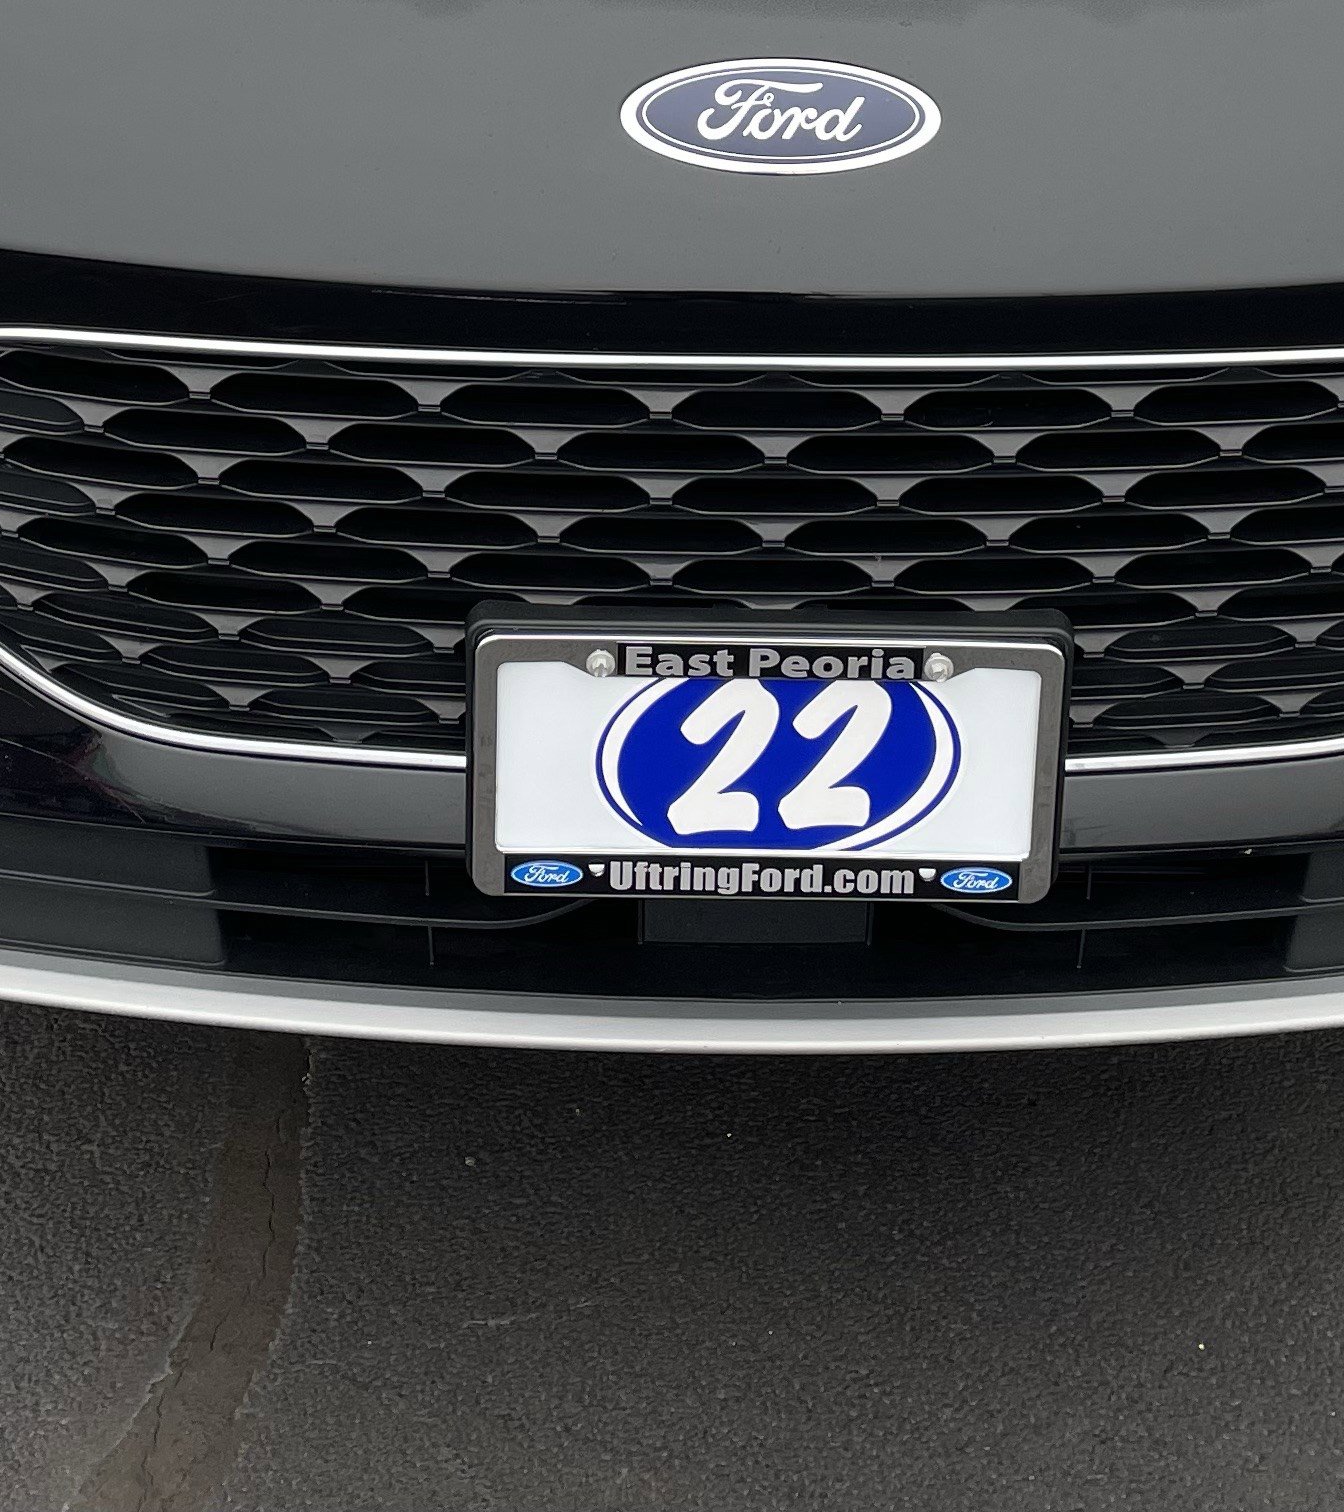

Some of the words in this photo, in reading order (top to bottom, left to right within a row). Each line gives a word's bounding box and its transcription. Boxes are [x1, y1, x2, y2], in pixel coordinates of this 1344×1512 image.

[696, 78, 866, 142] Ford
[624, 645, 735, 677] East
[748, 647, 916, 681] Peoria
[666, 679, 893, 836] 22
[523, 864, 570, 884] Ford
[609, 860, 915, 895] UftringFord.com
[953, 869, 1000, 890] Ford
